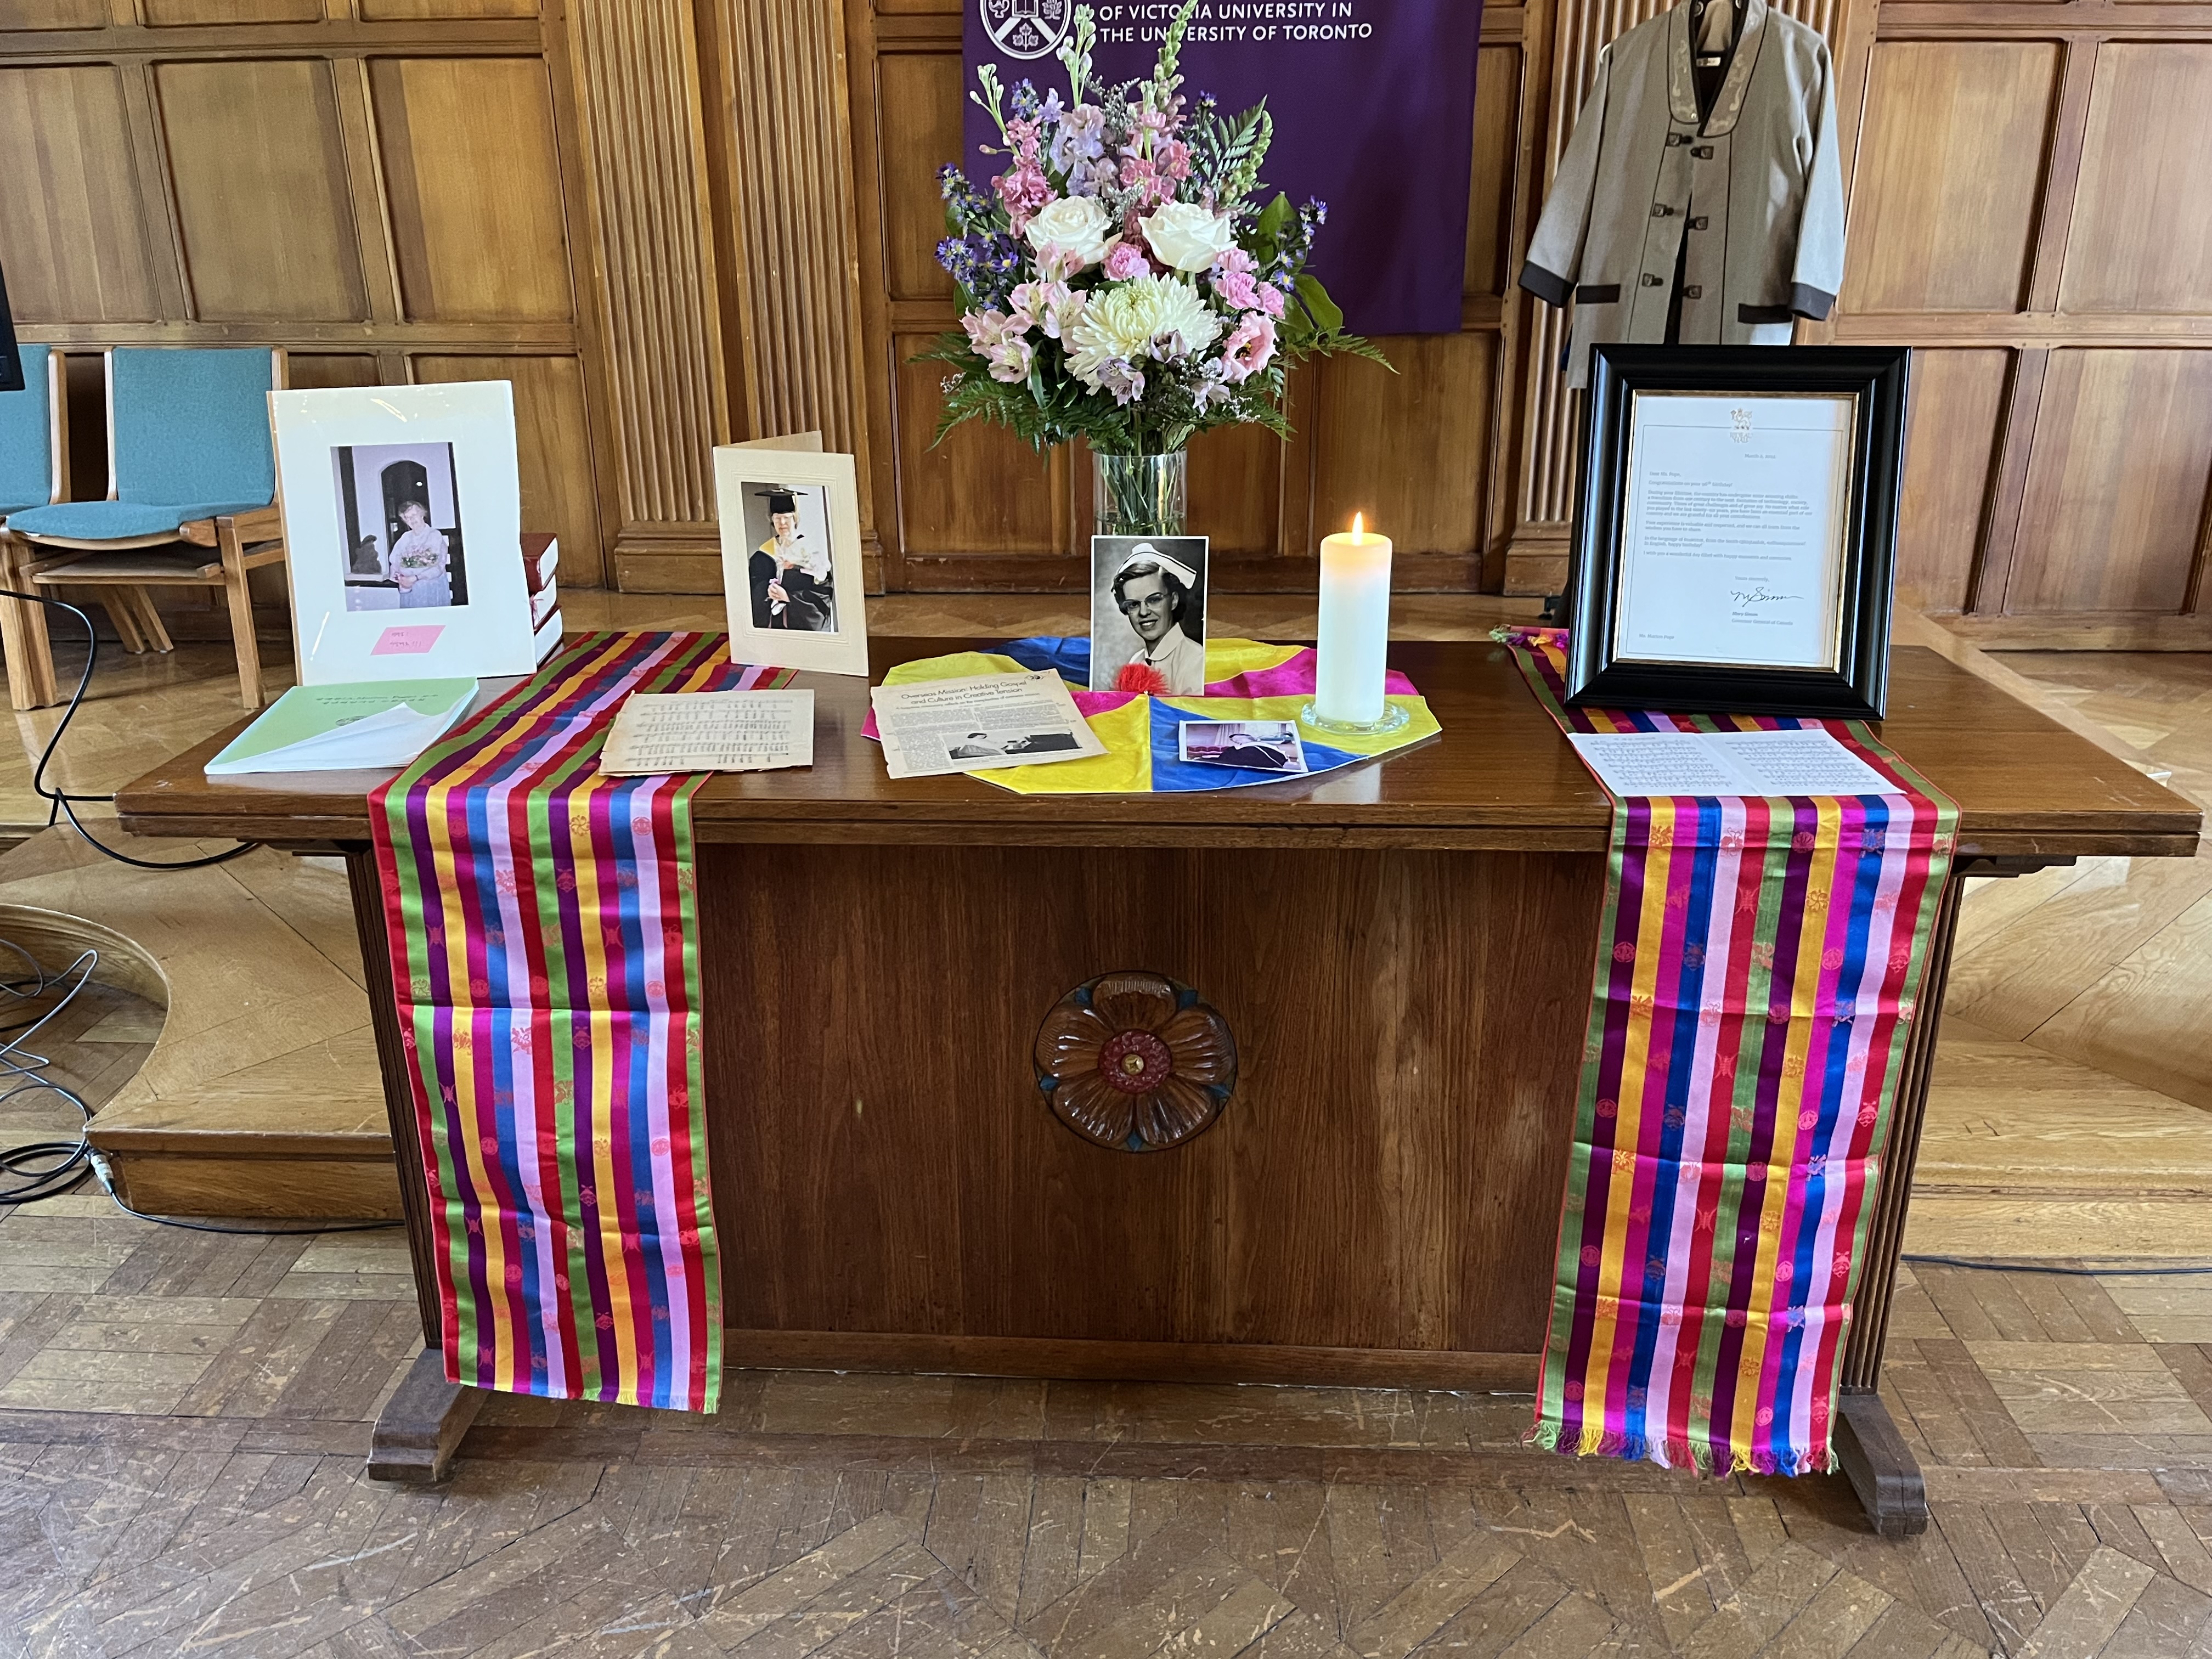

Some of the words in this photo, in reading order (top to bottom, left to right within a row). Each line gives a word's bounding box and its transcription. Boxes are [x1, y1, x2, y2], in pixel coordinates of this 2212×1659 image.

[1099, 5, 1123, 21] OF
[1128, 4, 1212, 20] VICTOIA
[1219, 2, 1325, 19] UNIVERSITY
[1332, 2, 1352, 18] IN
[1100, 27, 1133, 42] THE
[1141, 25, 1246, 42] UNERSITY
[1252, 25, 1277, 41] OF
[1283, 23, 1372, 41] TORONTO
